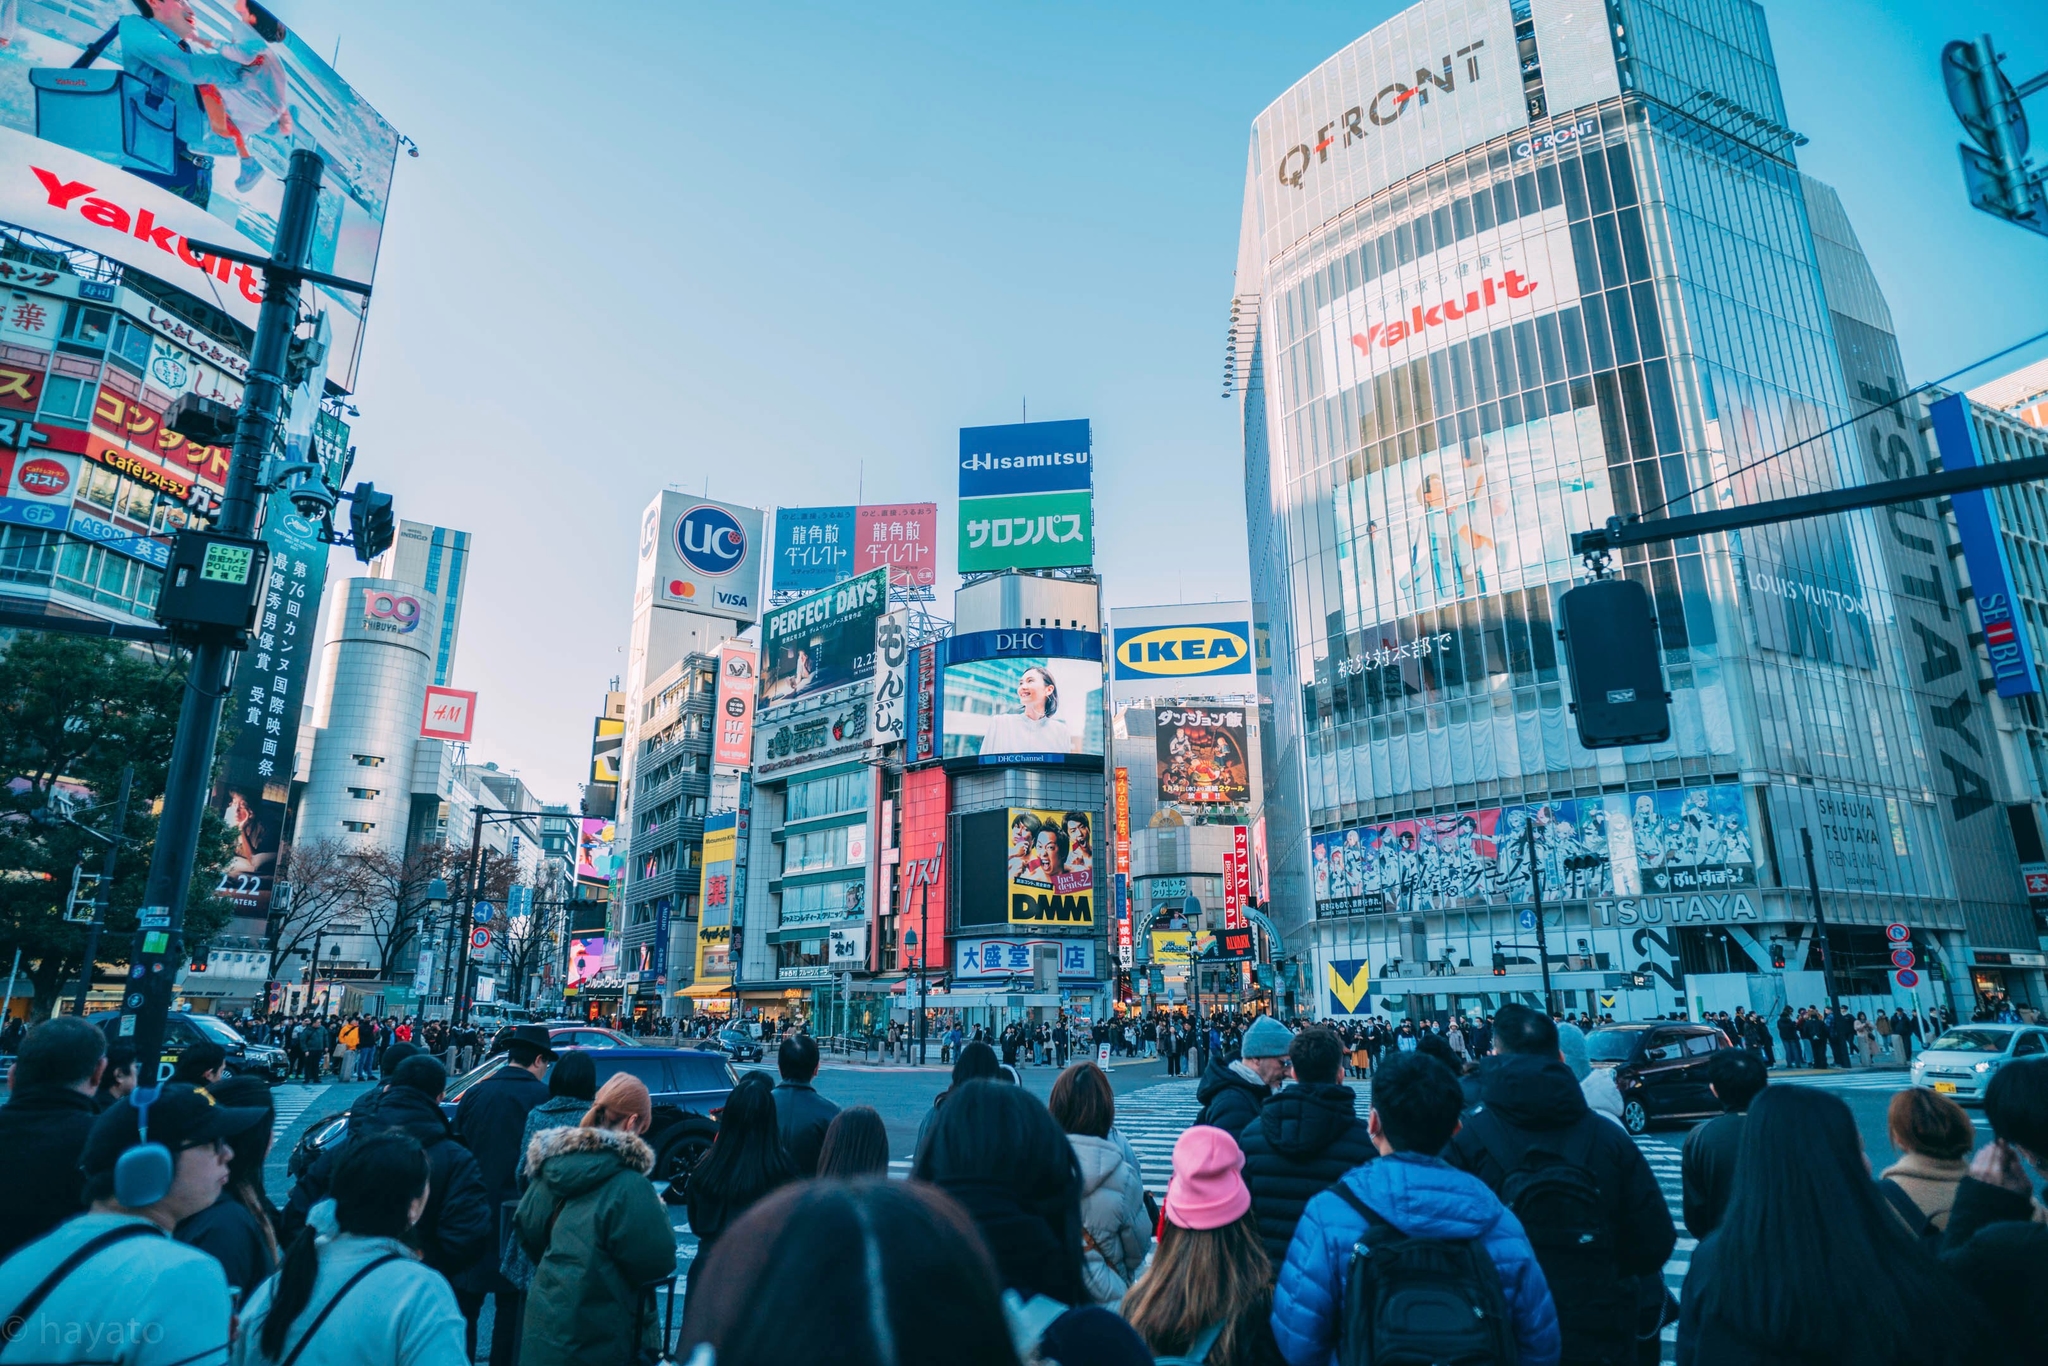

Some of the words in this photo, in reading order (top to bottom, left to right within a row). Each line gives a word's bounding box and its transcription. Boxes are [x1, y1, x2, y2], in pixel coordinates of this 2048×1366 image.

[55, 78, 88, 87] Yakult
[1278, 40, 1485, 190] QFRONT
[1516, 119, 1594, 158] QFRONT
[0, 302, 47, 331] 葉
[1347, 270, 1539, 358] Yakult
[961, 452, 1088, 471] Hisamitsu
[24, 473, 65, 488] ガスト
[26, 507, 53, 521] 6F
[80, 517, 127, 547] AEON
[792, 523, 840, 545] 龍角散
[873, 521, 921, 542] 龍角散
[967, 514, 1085, 549] サロンパス
[208, 554, 248, 565] 防犯カメラ
[209, 546, 249, 558] CCTV
[784, 546, 848, 566] ダイレクト
[865, 543, 929, 563] ダイレクト
[205, 562, 246, 573] POLICE
[205, 570, 244, 581] 警視庁
[716, 592, 748, 607] VISA
[1747, 570, 1797, 600] LOUIS
[1798, 582, 1869, 617] VUITTON
[1858, 375, 1995, 822] TSUTAYA
[254, 552, 289, 672] 最優秀男優賞
[363, 588, 421, 633] 109
[769, 595, 832, 640] PERFECT
[836, 579, 878, 615] DAYS
[363, 619, 397, 633] SHIBUYA
[996, 632, 1044, 651] DHC
[1128, 638, 1239, 663] IKEA
[257, 560, 307, 777] 第76回カンヌ国際映画祭
[874, 614, 905, 738] もんじゃ
[245, 685, 265, 726] 受賞
[433, 704, 462, 723] H&M
[1158, 710, 1243, 728] ダンジョン飯
[998, 755, 1015, 763] DHC
[1117, 770, 1127, 836] クスリのことなら
[1819, 799, 1874, 820] SHIBUYA
[1823, 825, 1879, 845] TSUTAYA
[1235, 833, 1249, 888] カラオケ
[1827, 850, 1887, 871] RENEWAL
[215, 872, 262, 895] 2.22
[707, 875, 727, 907] 薬
[1152, 889, 1187, 898] クリニック
[1161, 880, 1186, 888] れいわ
[2028, 875, 2048, 892] 本
[218, 897, 258, 906] TEATERS
[1012, 893, 1092, 922] DMM
[1226, 895, 1236, 929] カラオ
[1594, 893, 1757, 926] TSUTAYA
[661, 907, 669, 931] MIZUHO
[962, 944, 1086, 970] 大盛堂店
